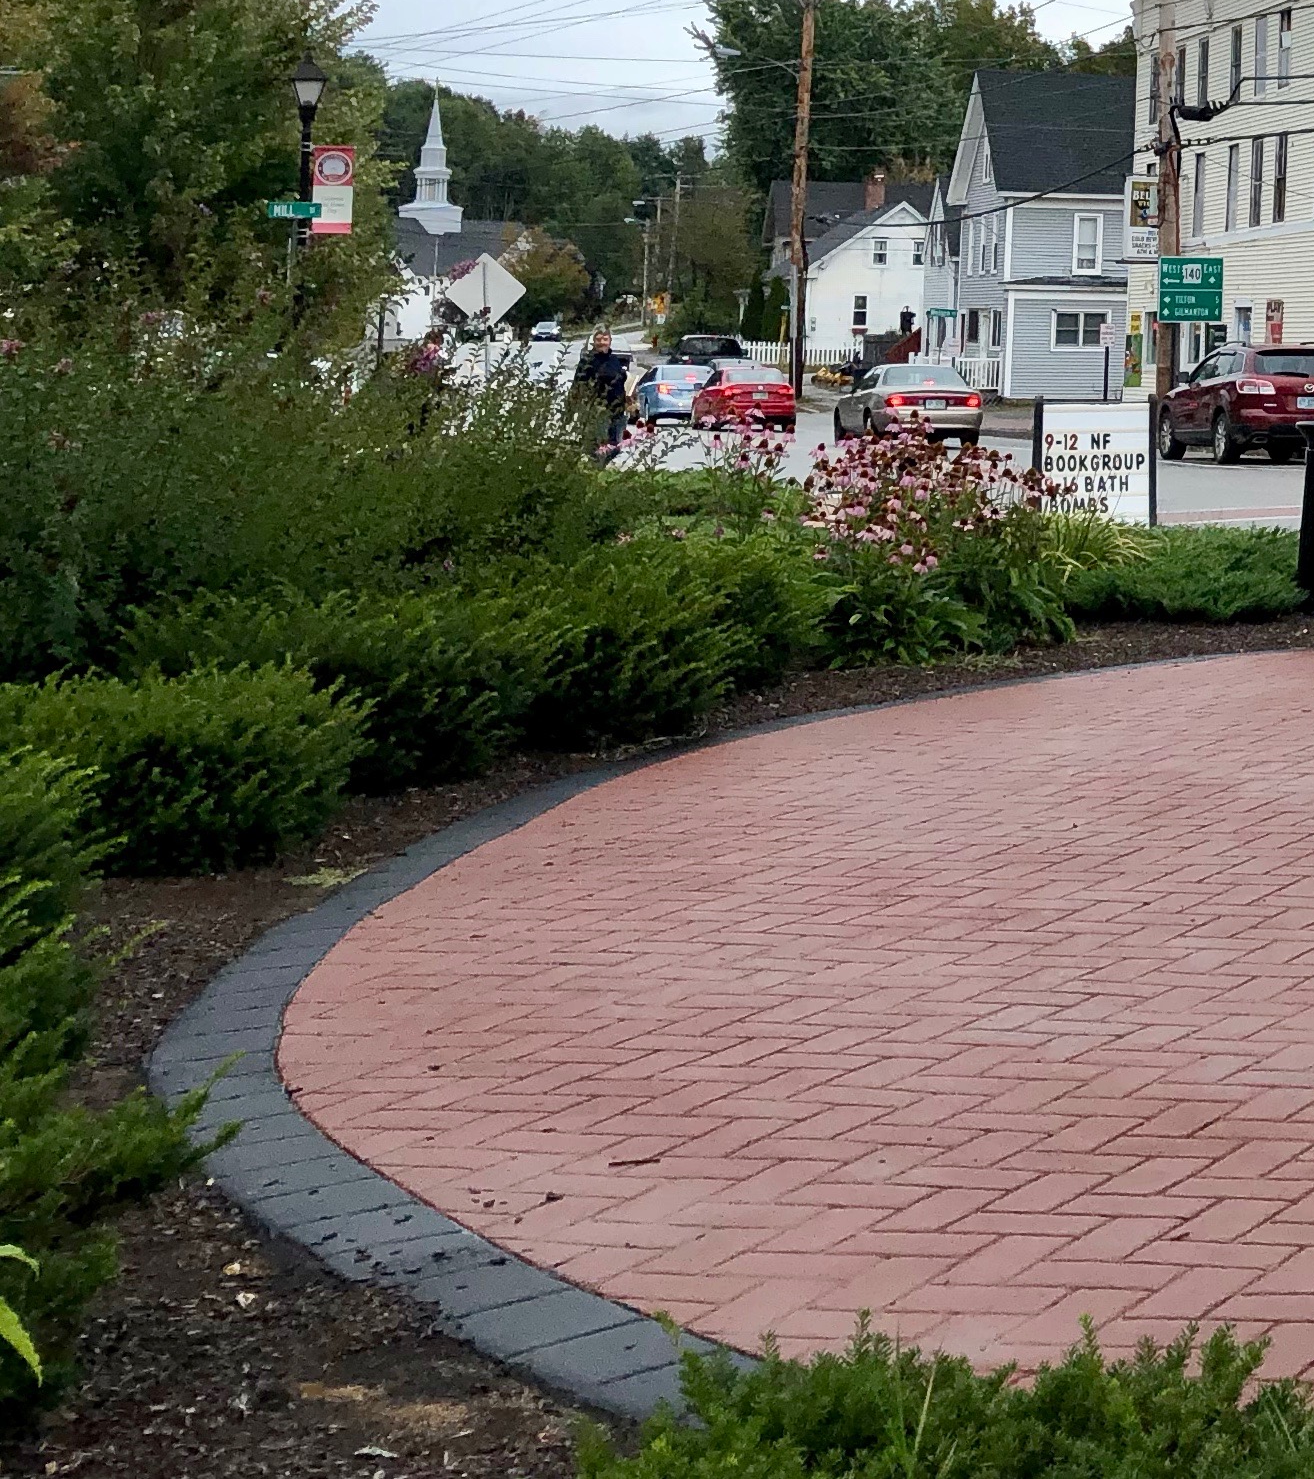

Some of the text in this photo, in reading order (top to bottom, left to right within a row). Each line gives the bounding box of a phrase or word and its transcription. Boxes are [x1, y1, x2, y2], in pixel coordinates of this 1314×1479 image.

[273, 204, 295, 218] MILL
[1184, 268, 1201, 281] 140
[1215, 295, 1220, 304] 5
[1044, 433, 1111, 451] 9-12 NF
[1044, 453, 1145, 472] BOOKGROUP
[1084, 474, 1129, 493] BATH
